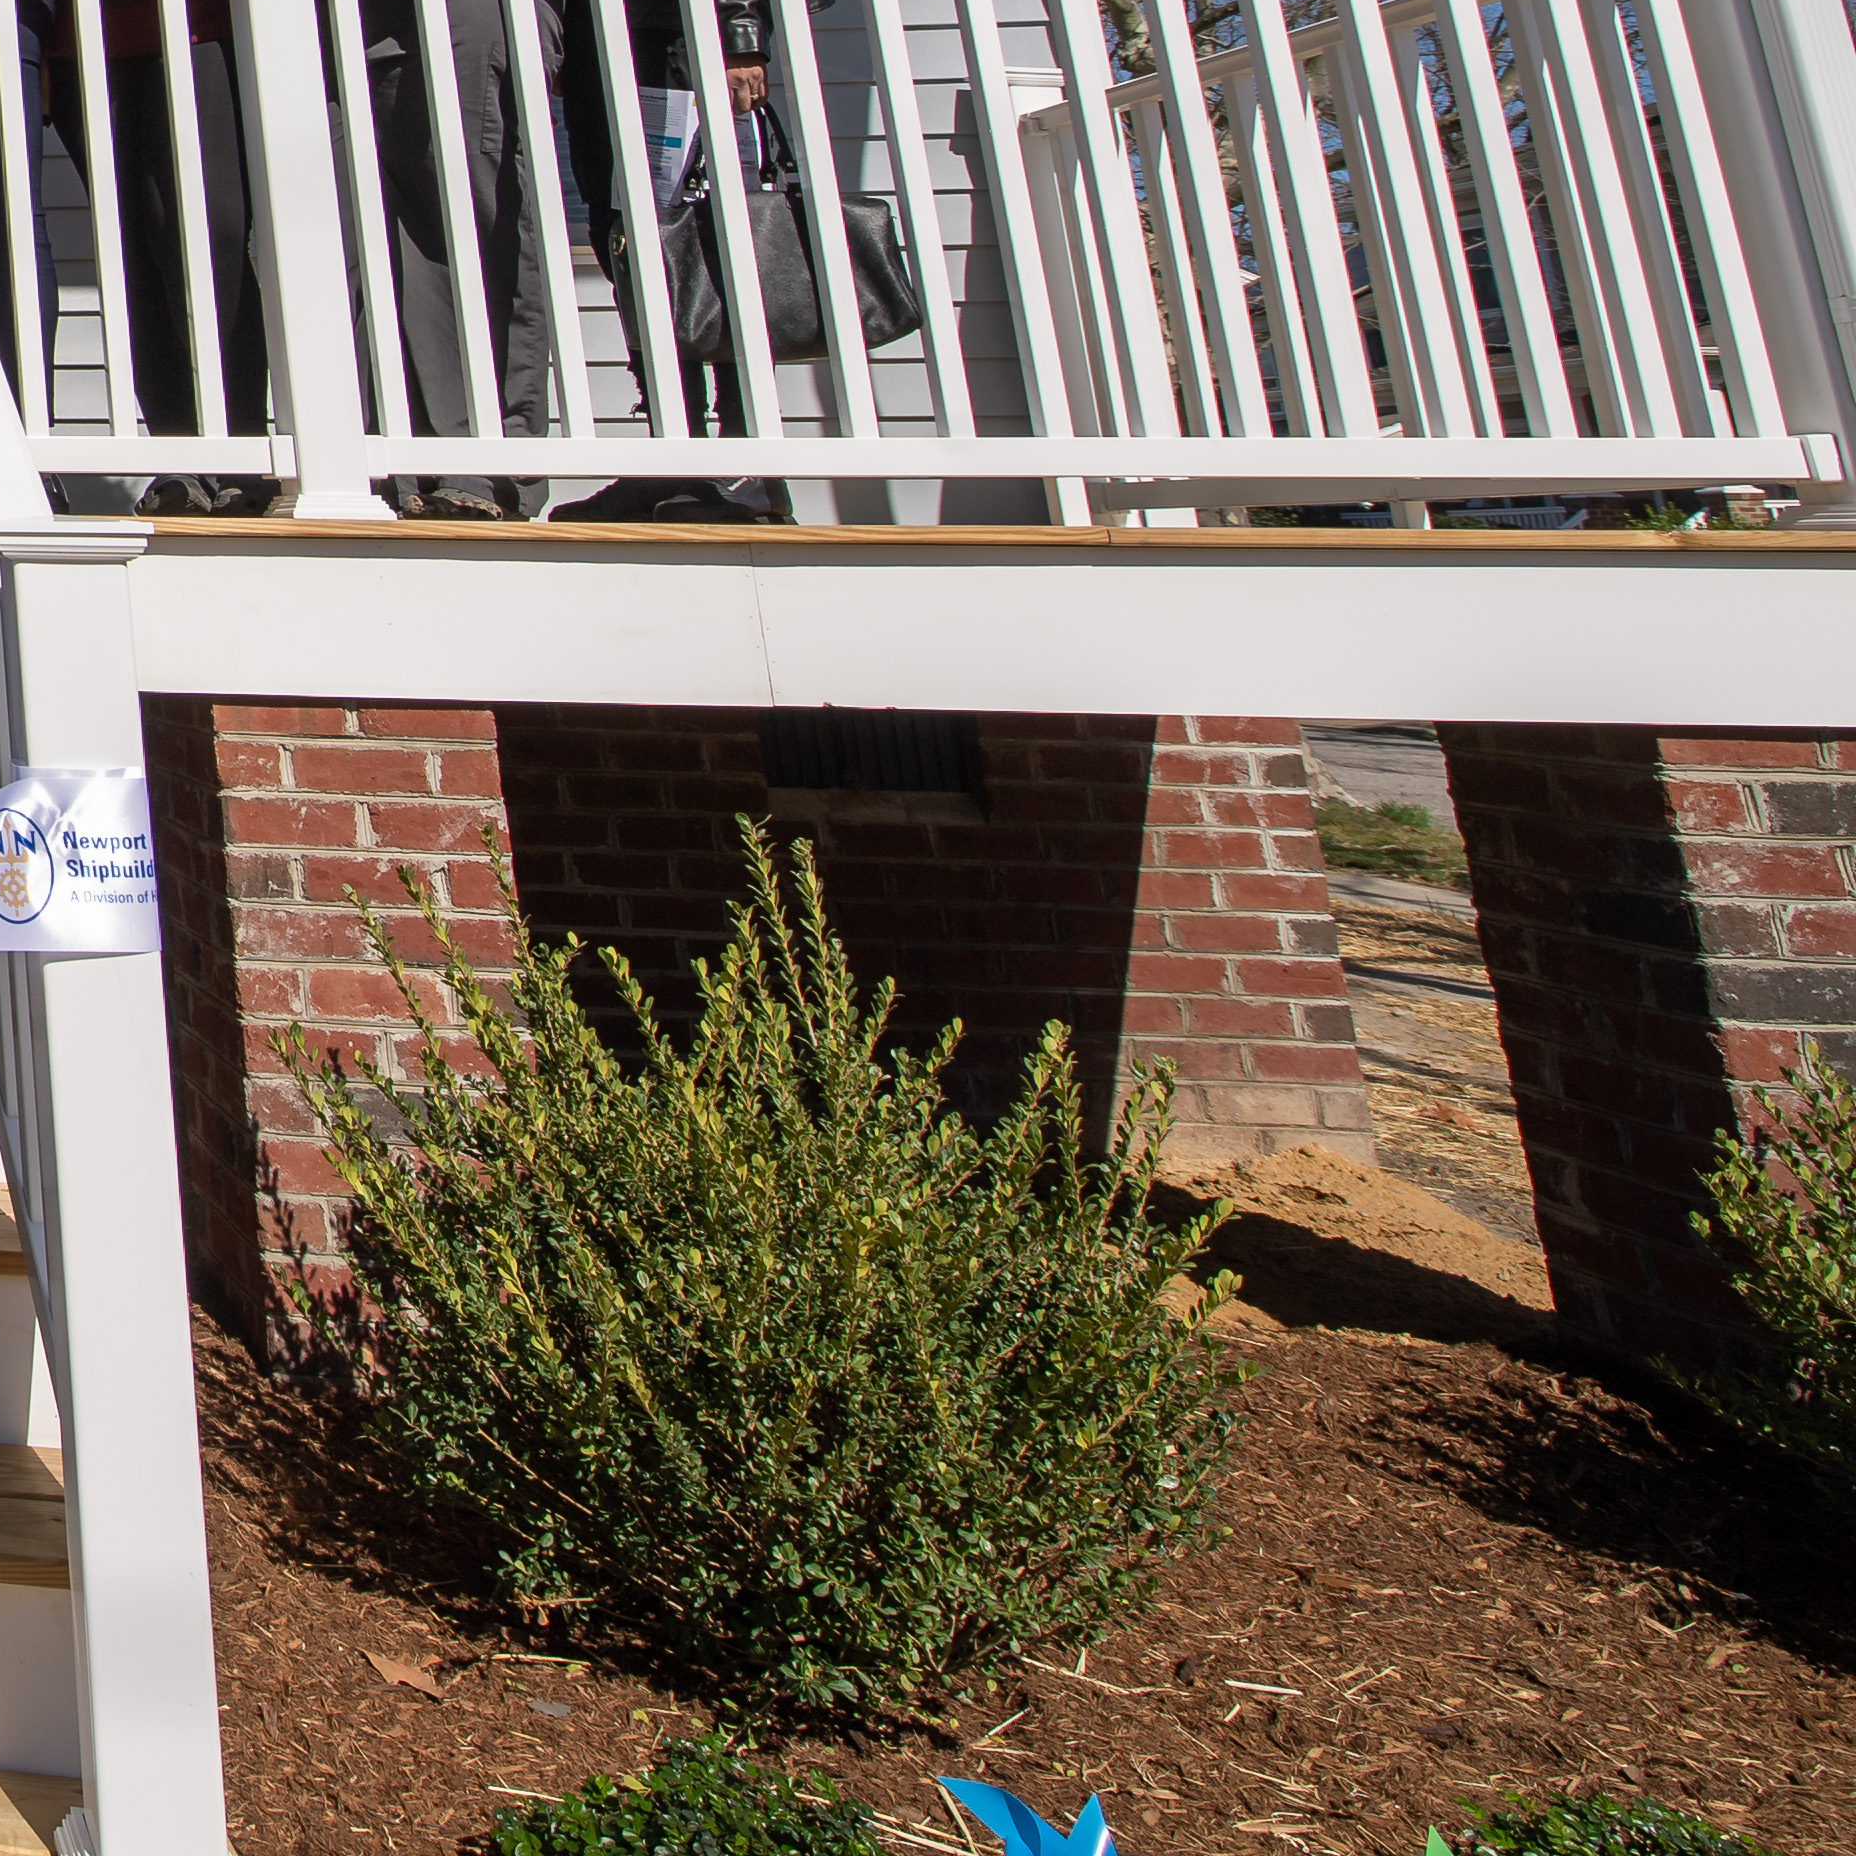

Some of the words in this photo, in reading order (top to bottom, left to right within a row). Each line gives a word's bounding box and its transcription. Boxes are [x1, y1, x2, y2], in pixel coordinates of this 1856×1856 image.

[63, 831, 147, 853] Newport
[66, 859, 155, 883] Shipbuild
[70, 890, 80, 903] A
[84, 890, 136, 904] Division
[138, 890, 151, 904] of
